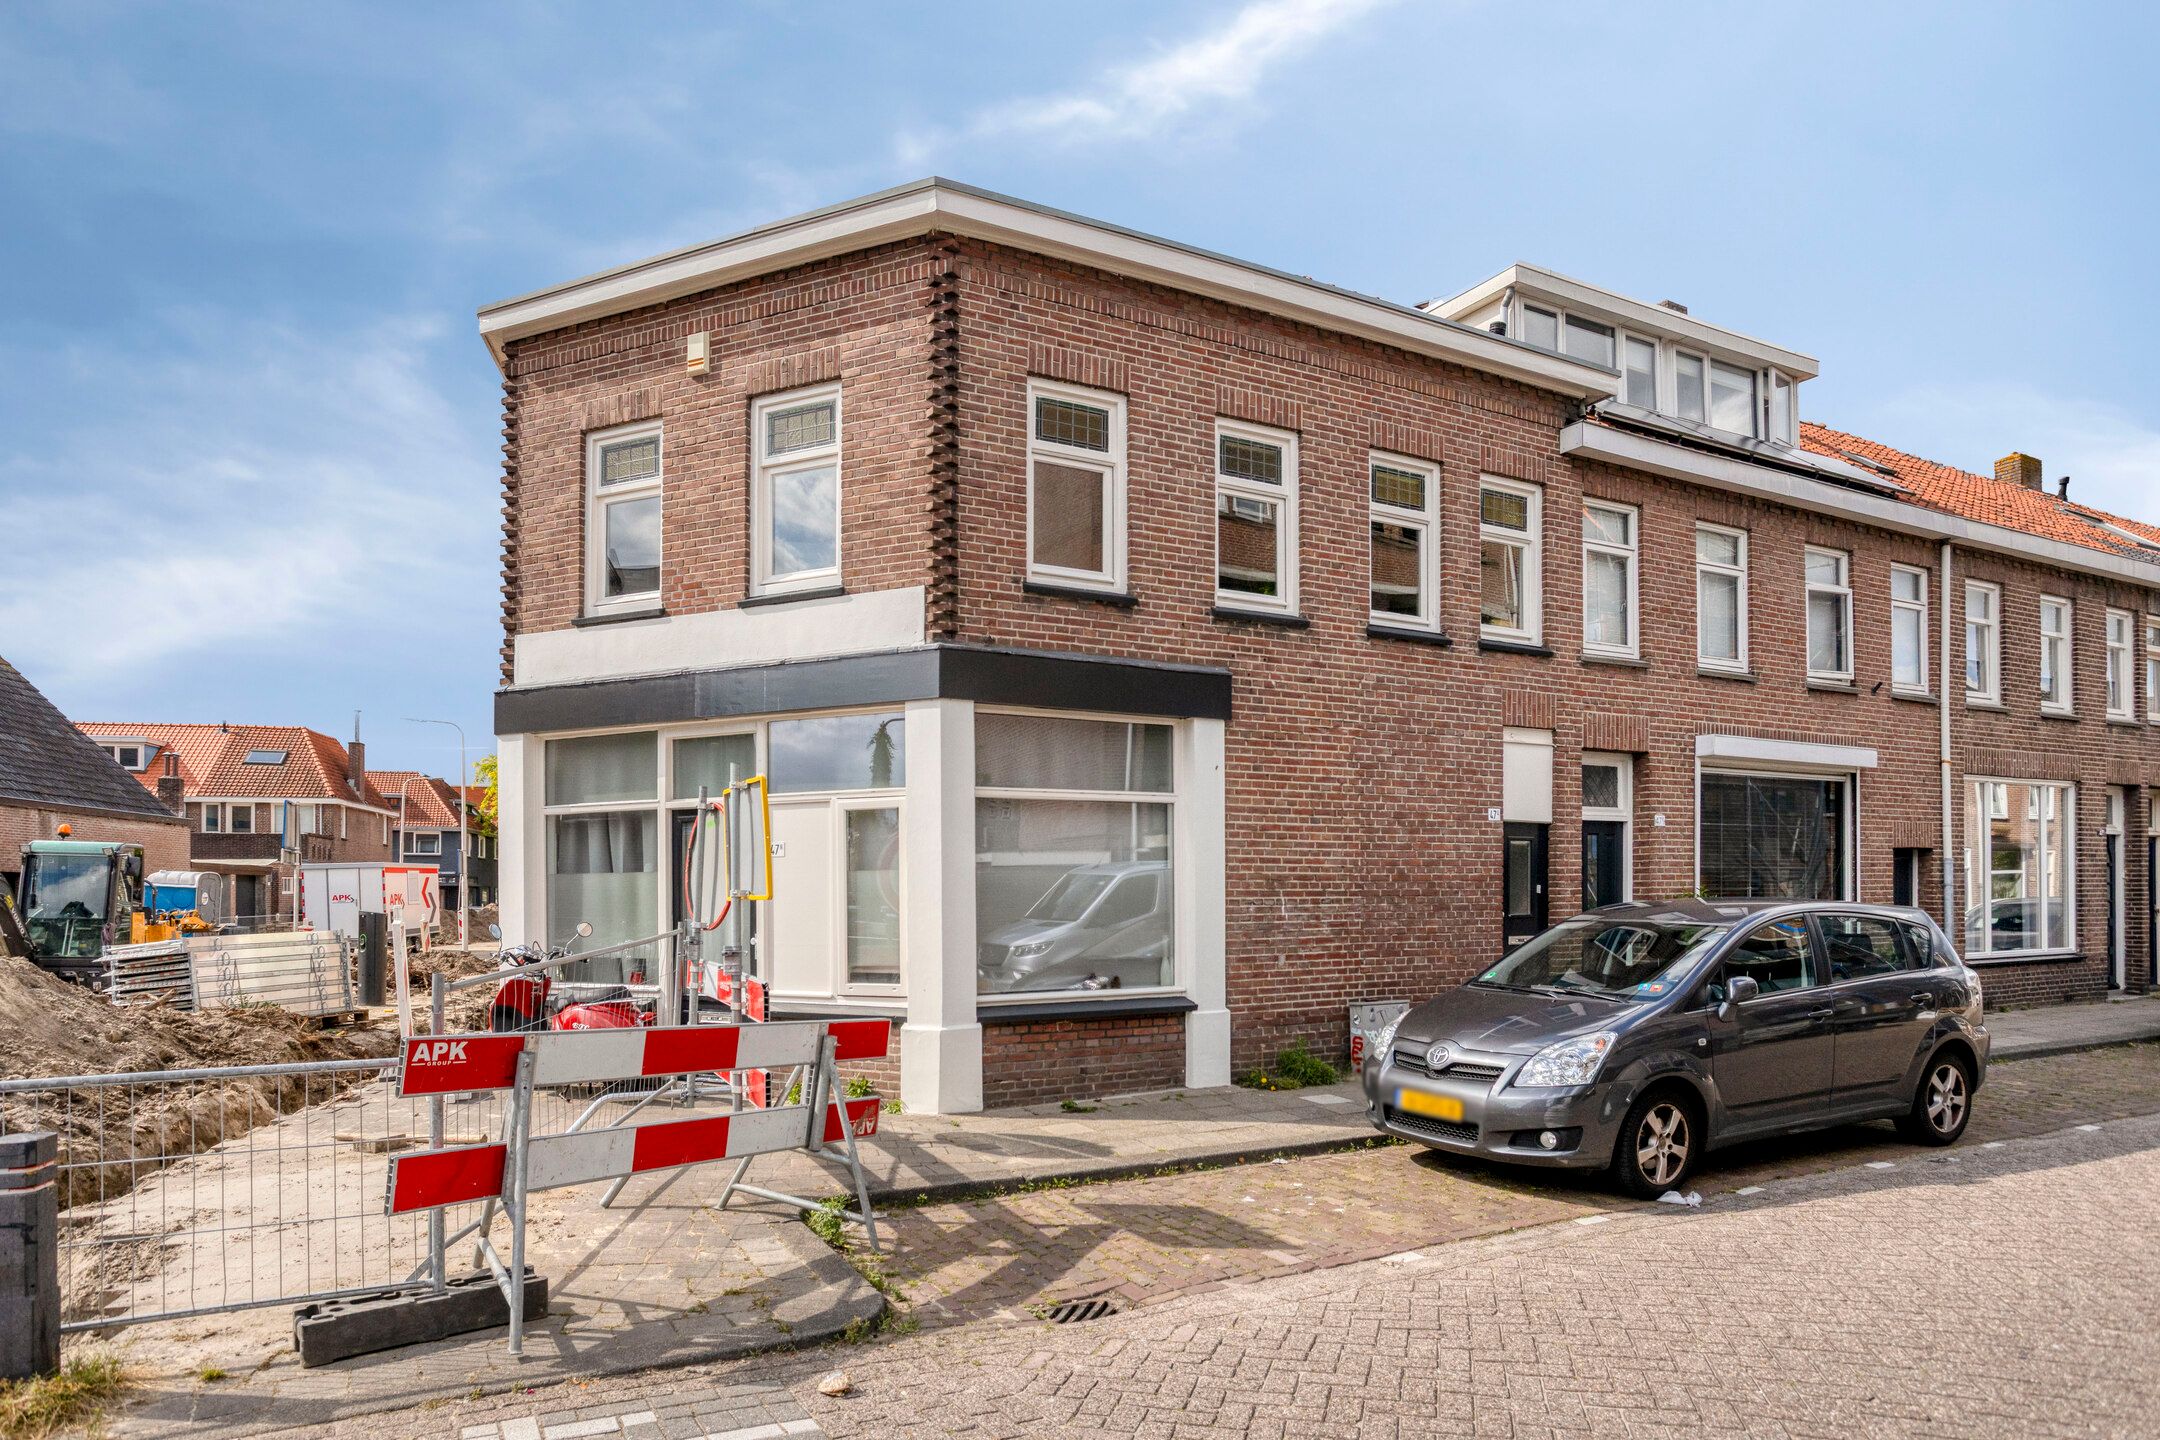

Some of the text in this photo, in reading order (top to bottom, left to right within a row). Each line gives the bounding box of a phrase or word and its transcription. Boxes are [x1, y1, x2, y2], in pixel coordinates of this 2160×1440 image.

[389, 893, 403, 905] APK
[411, 1041, 469, 1063] APK
[852, 1117, 876, 1134] AP
